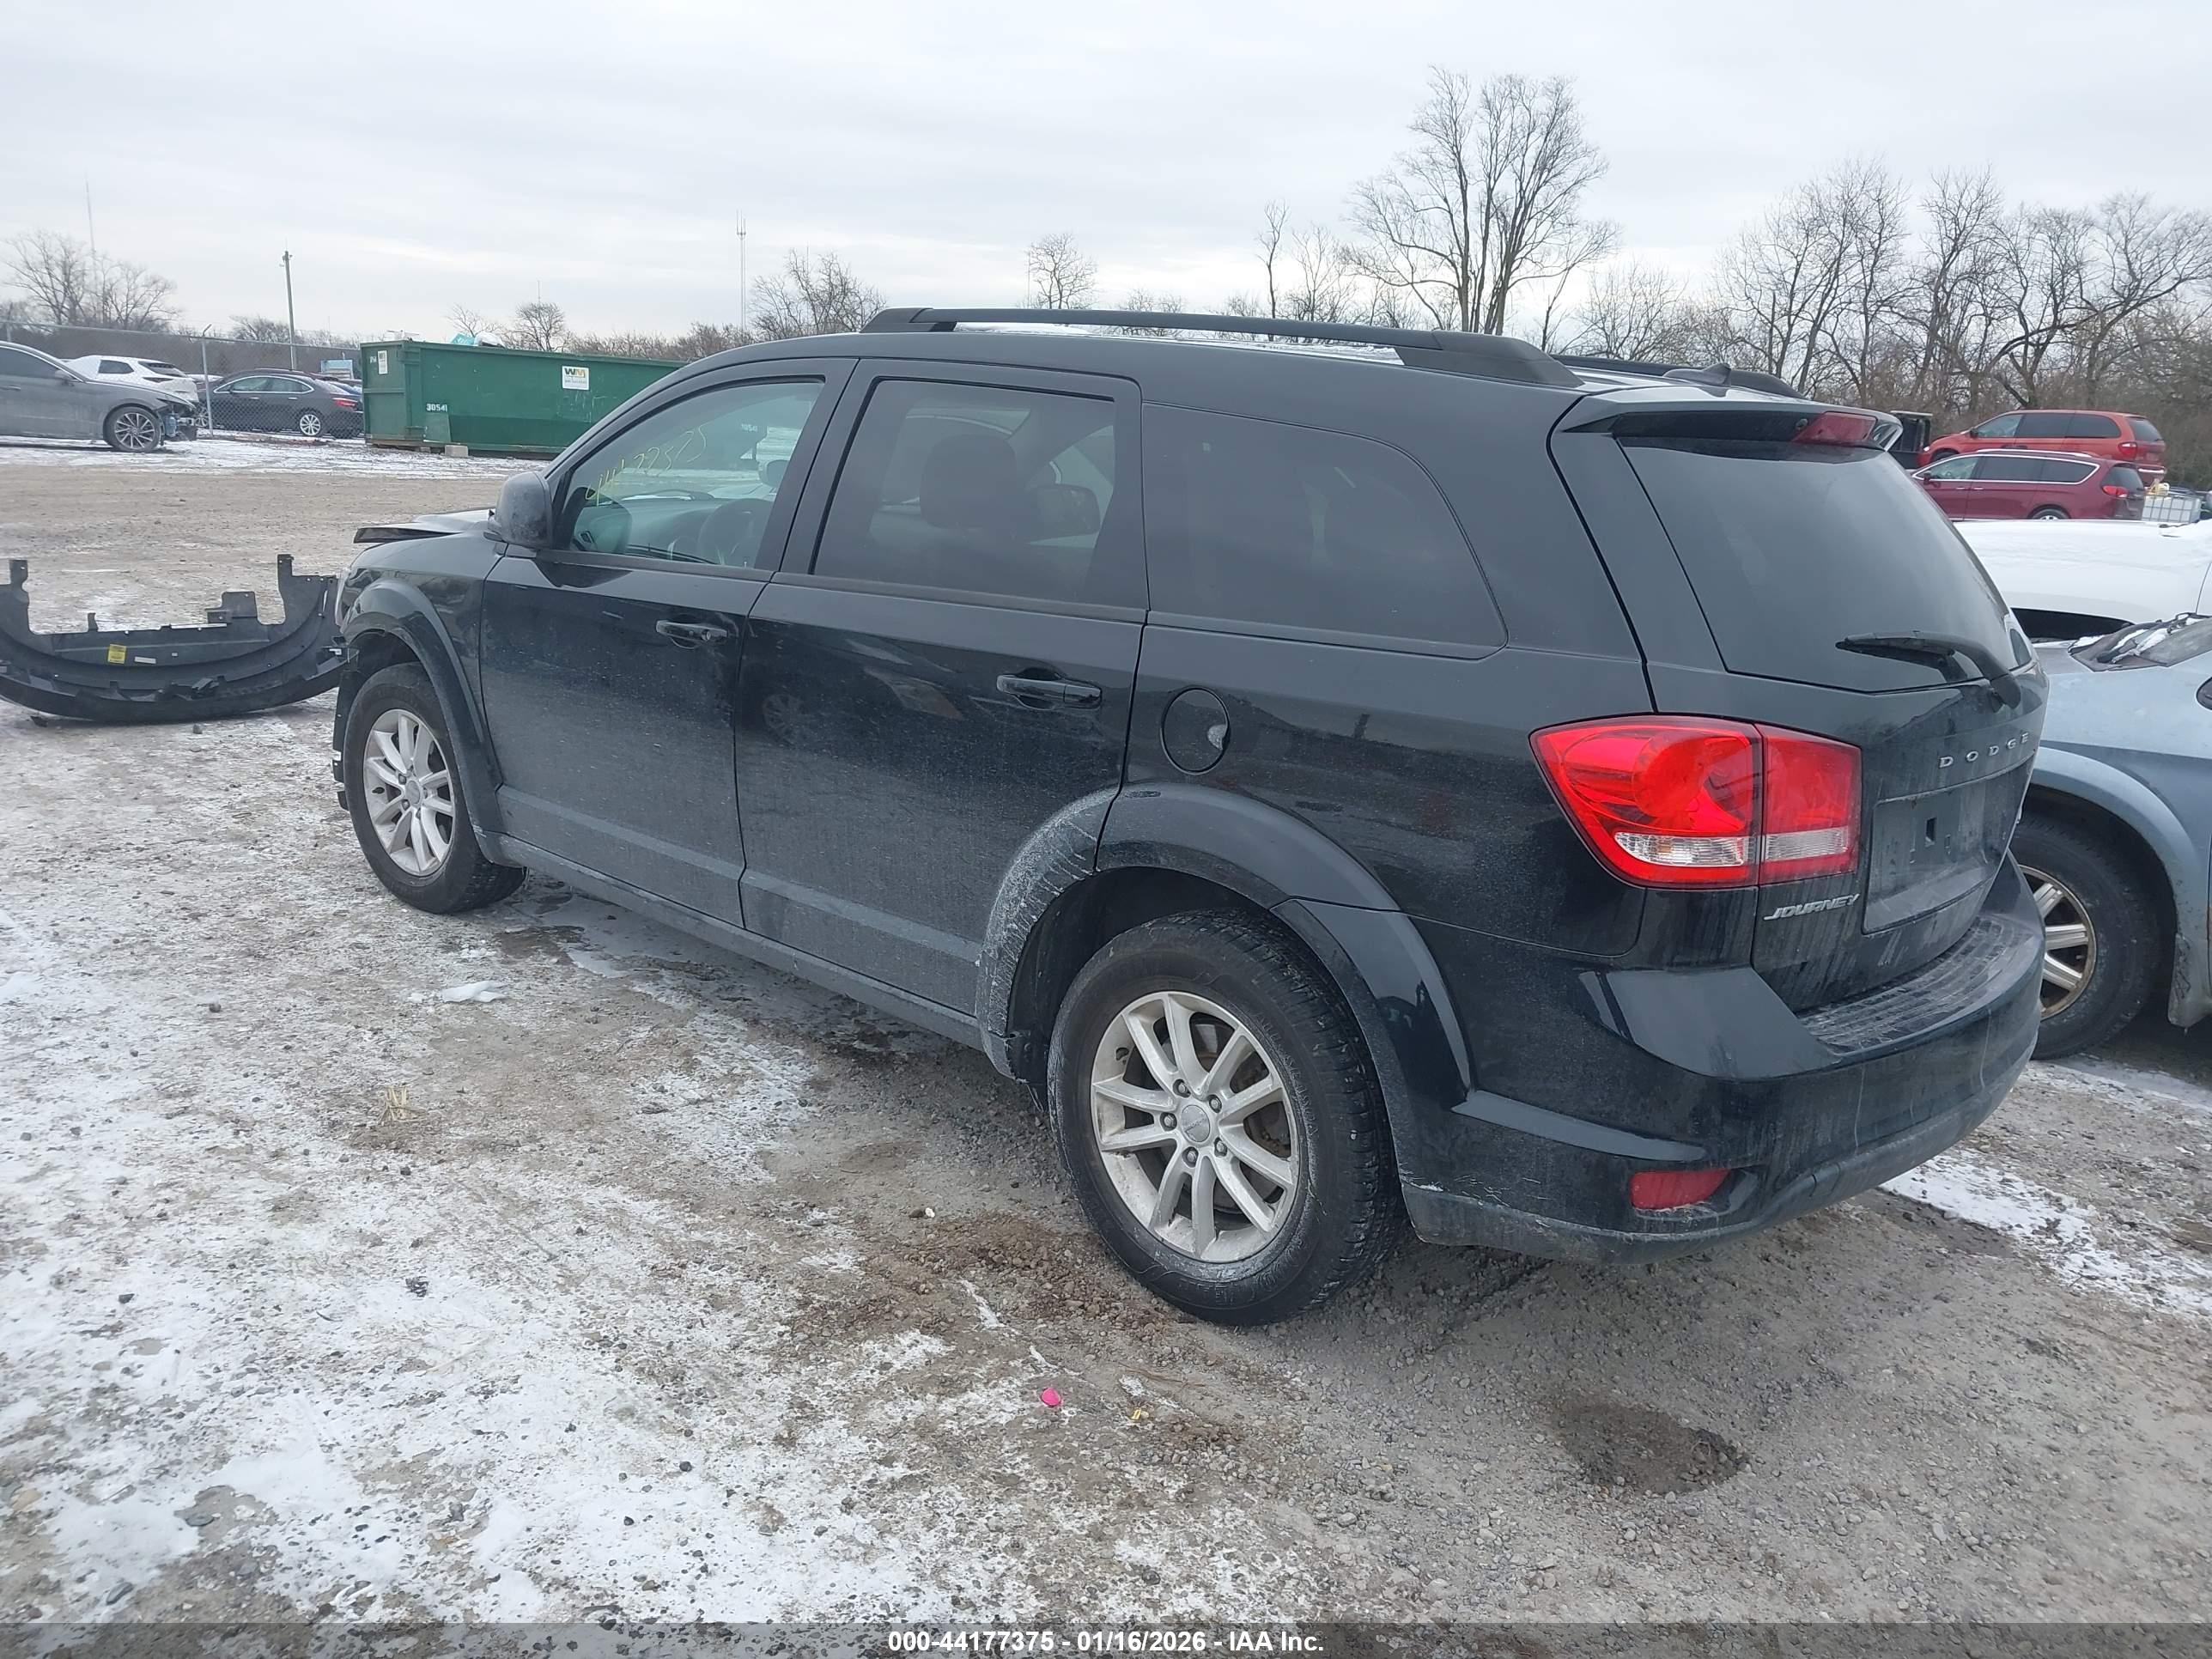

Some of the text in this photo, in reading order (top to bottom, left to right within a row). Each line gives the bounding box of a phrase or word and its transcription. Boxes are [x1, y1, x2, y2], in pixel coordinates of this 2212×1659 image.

[564, 368, 585, 378] WM
[426, 403, 448, 413] 30541
[1939, 732, 2029, 769] DODGE
[1763, 893, 1861, 921] JOURNEY
